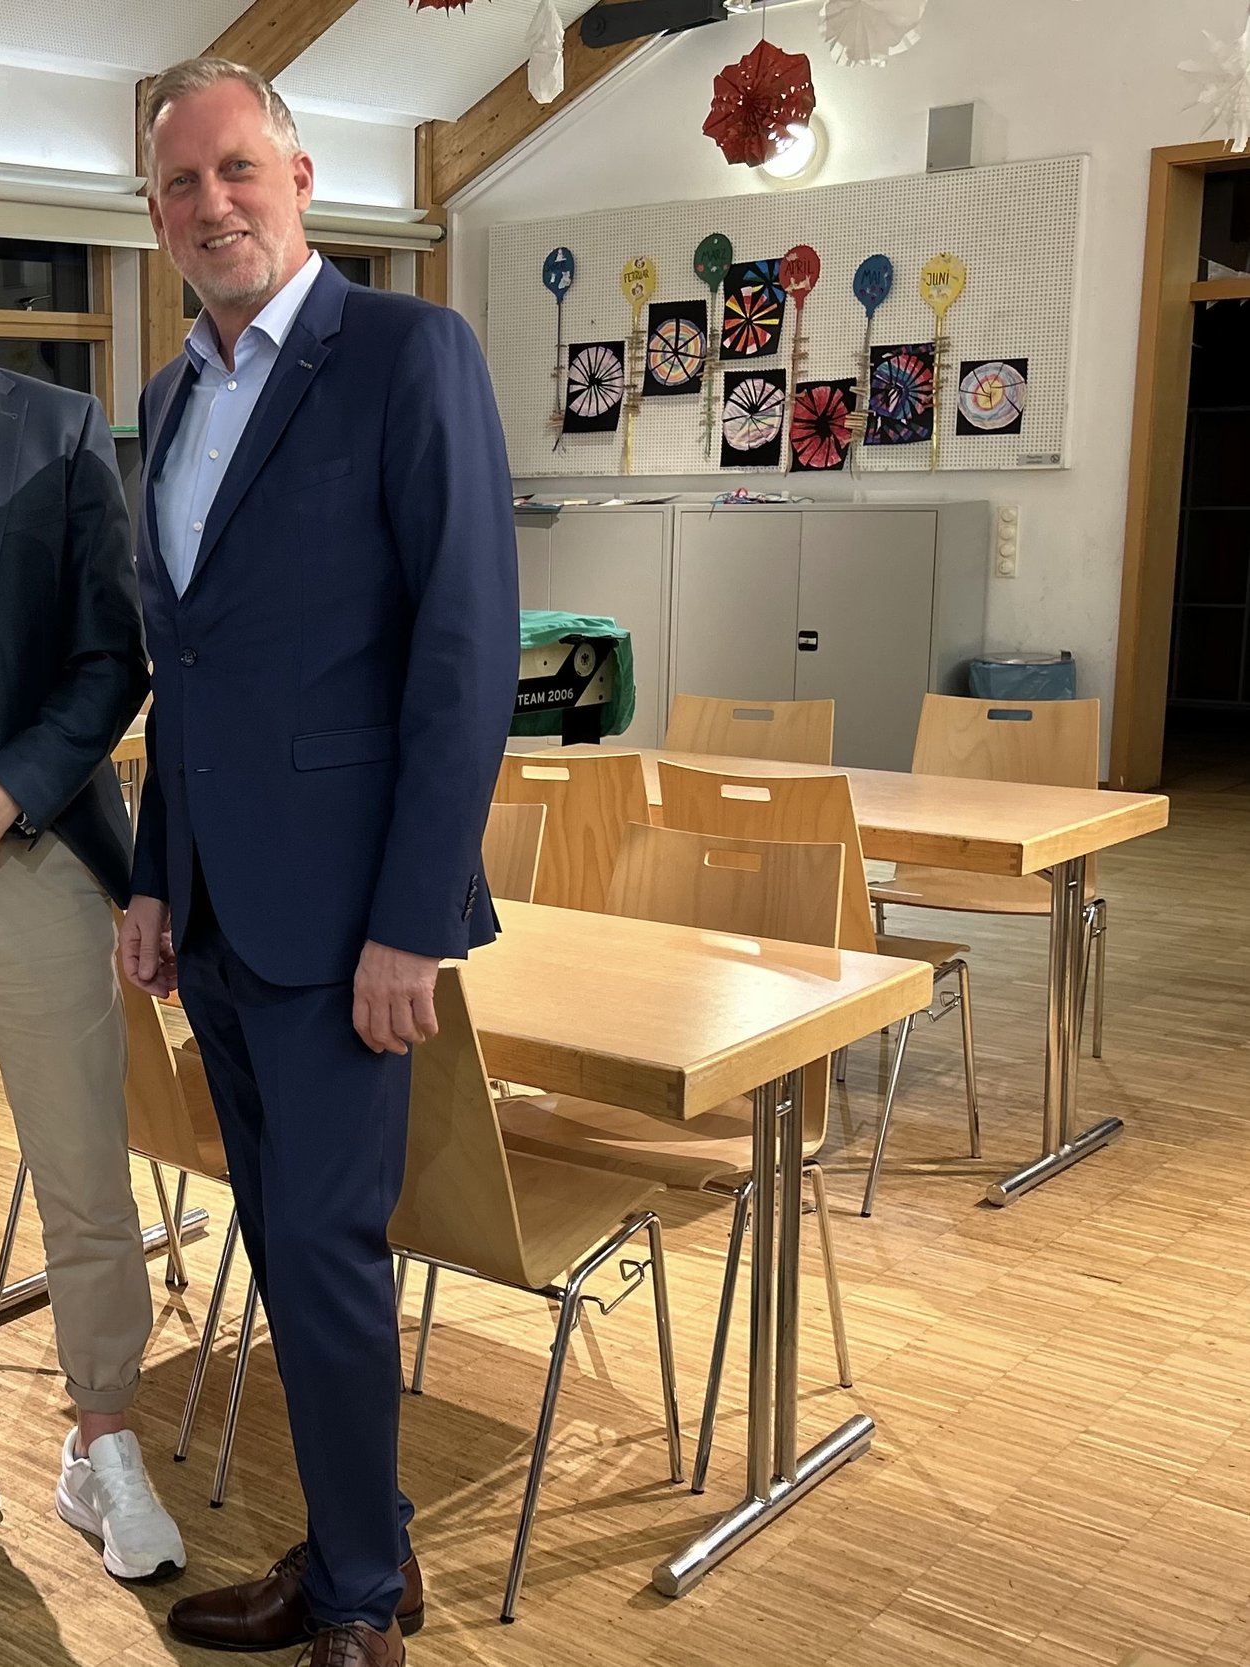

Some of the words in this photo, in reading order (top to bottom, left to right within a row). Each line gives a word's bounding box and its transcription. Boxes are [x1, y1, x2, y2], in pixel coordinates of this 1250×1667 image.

[784, 260, 814, 276] APRIL
[861, 269, 881, 285] MAI
[926, 270, 950, 286] JUNI
[518, 692, 545, 706] TEAM
[547, 688, 574, 702] 2006
